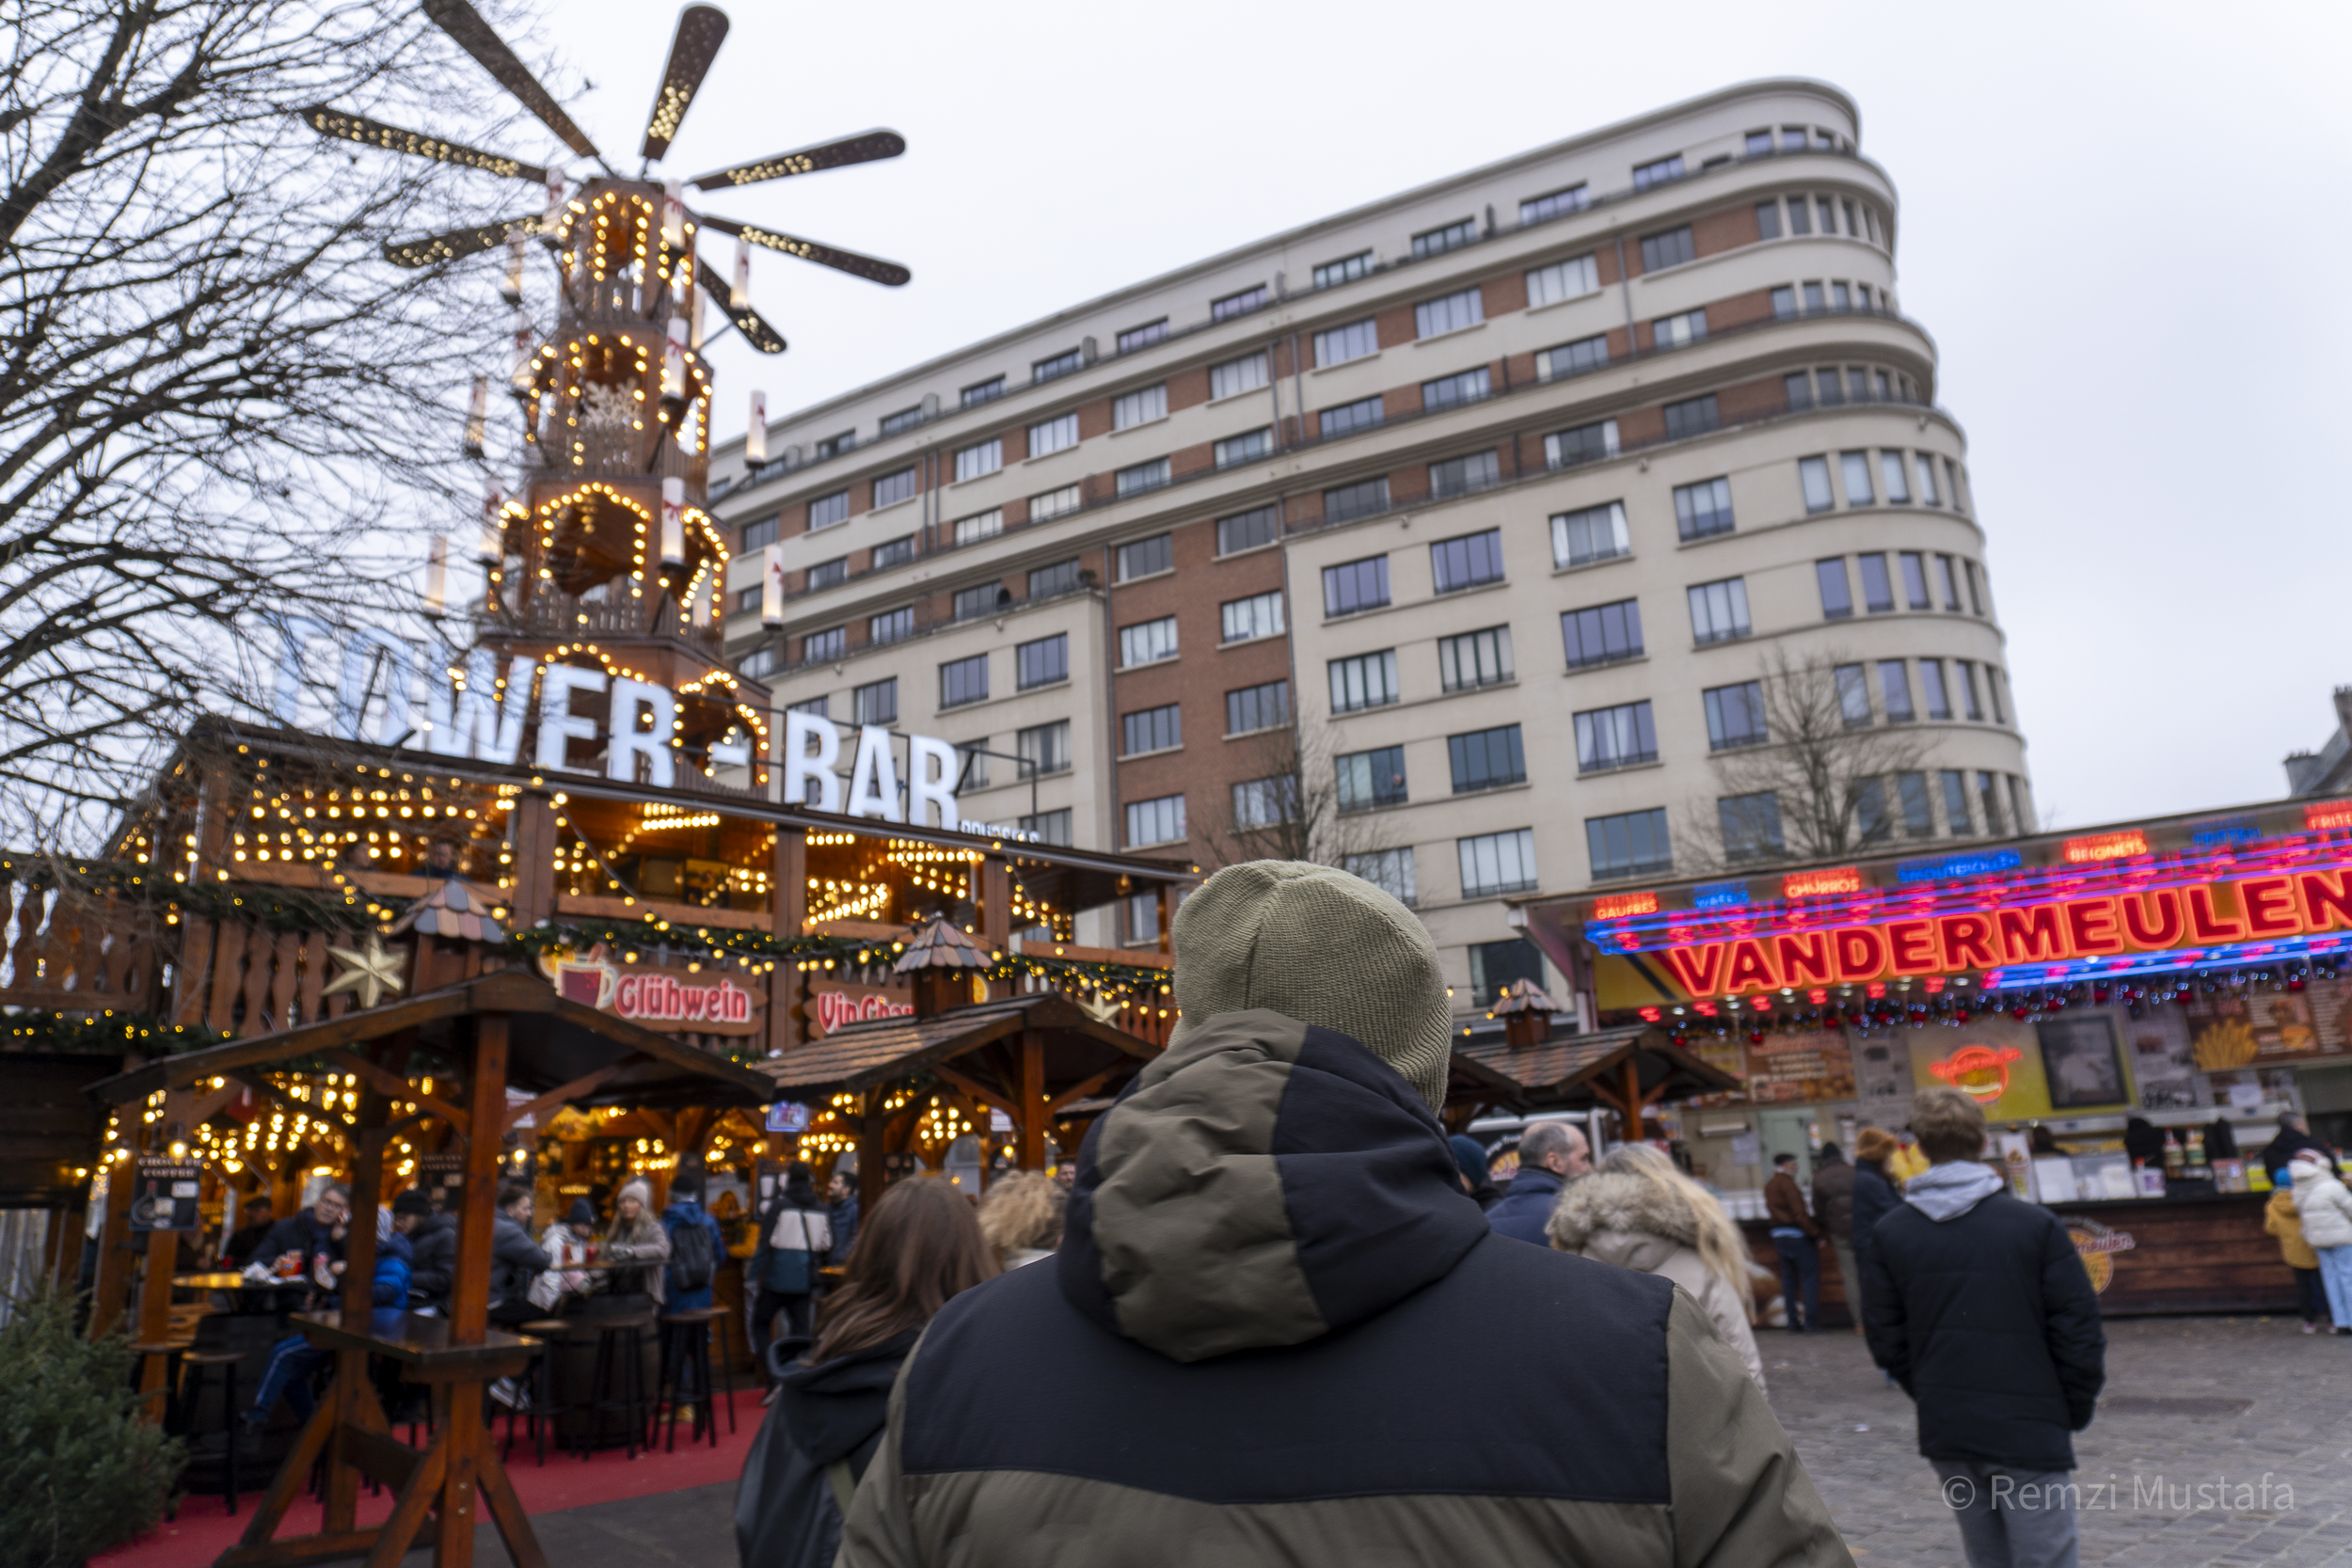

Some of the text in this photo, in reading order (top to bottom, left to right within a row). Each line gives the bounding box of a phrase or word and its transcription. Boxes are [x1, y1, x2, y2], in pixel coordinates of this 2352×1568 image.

[260, 611, 675, 787] TOWER
[785, 709, 959, 832] BAR
[2065, 838, 2146, 863] BEIGNETS
[1786, 879, 1861, 898] CHURROS
[1596, 902, 1658, 920] GAUFRES
[1670, 867, 2352, 997] VANDERMEULEN
[614, 974, 752, 1023] Glühwein
[818, 990, 858, 1033] Vin
